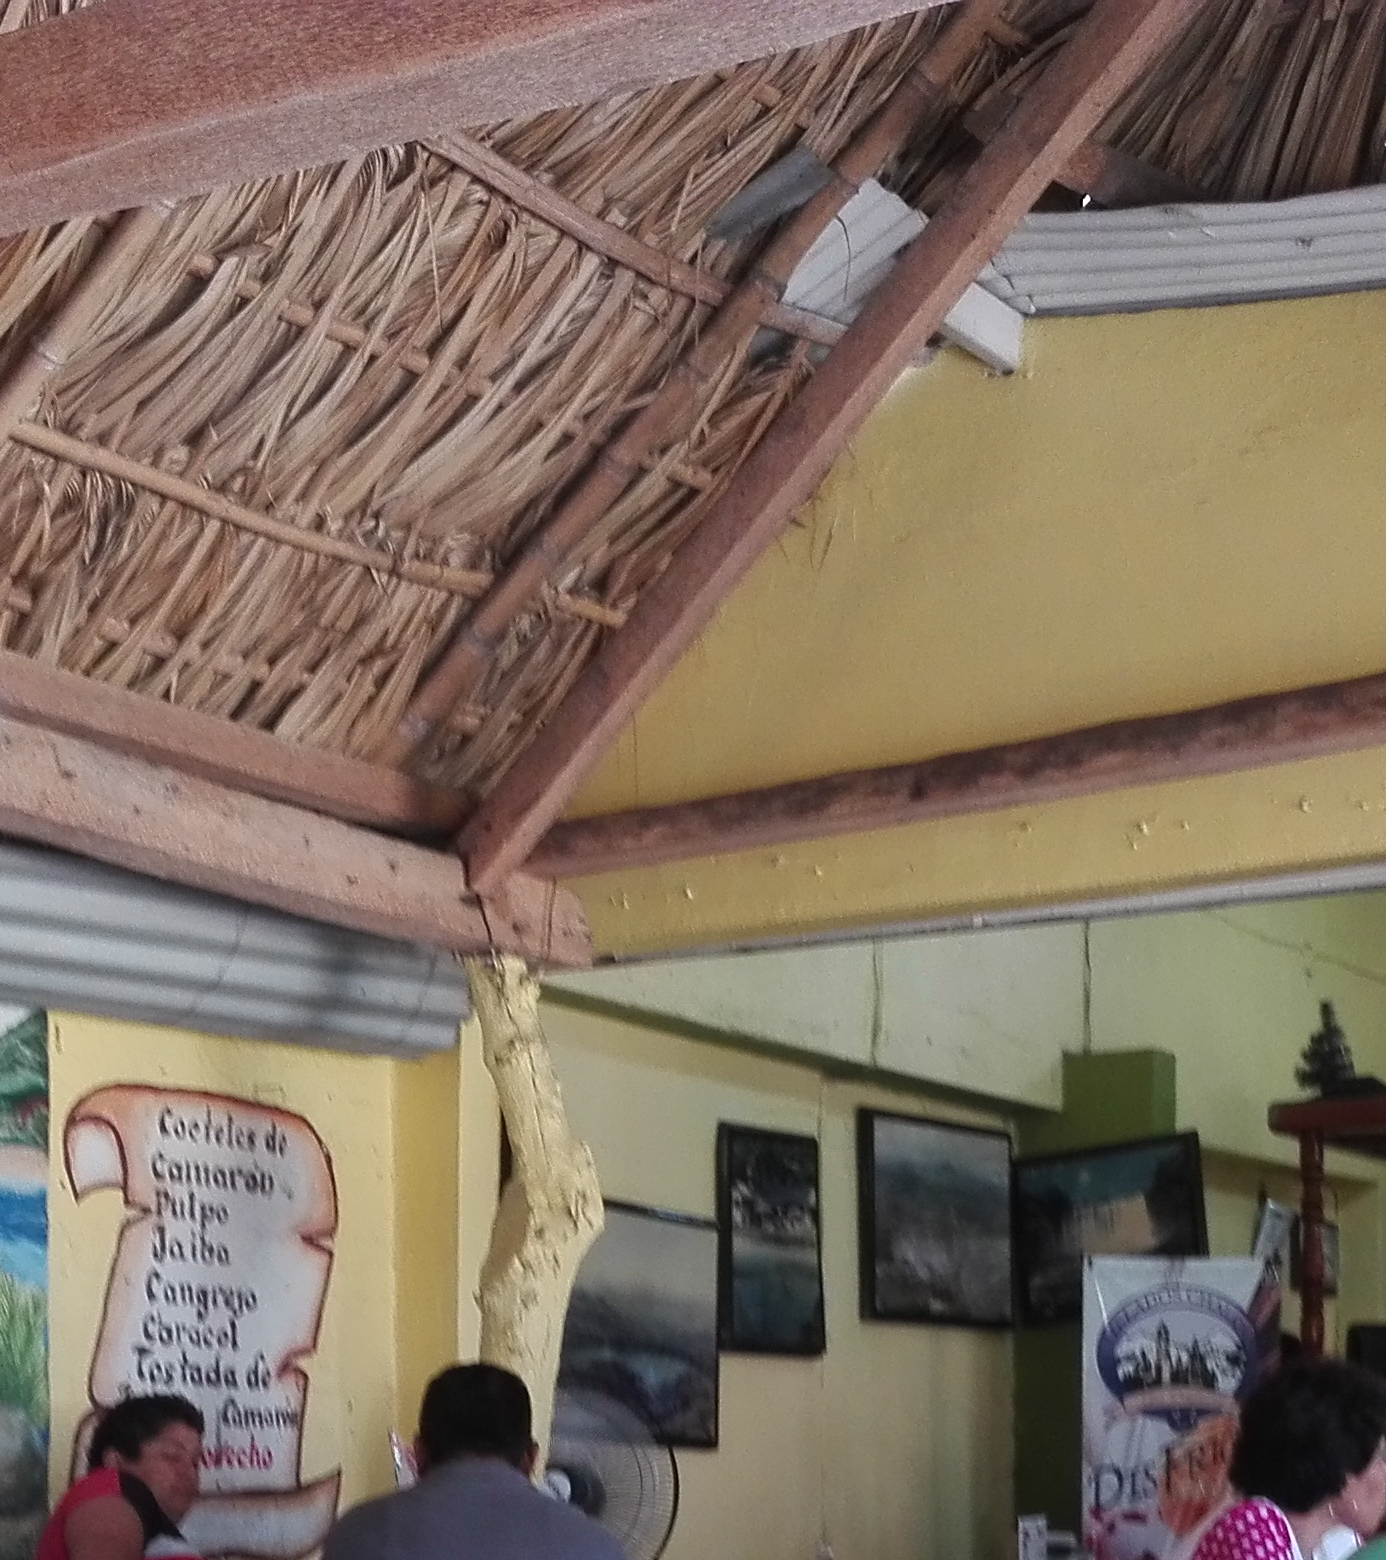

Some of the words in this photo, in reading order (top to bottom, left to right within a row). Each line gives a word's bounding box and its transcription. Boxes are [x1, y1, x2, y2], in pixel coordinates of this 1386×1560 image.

[158, 1103, 257, 1152] Cocteles
[264, 1118, 288, 1158] de
[154, 1187, 229, 1232] Pulpo
[151, 1224, 231, 1266] Jaiba
[144, 1267, 258, 1321] Cangrejo
[132, 1344, 239, 1388] Tostada
[246, 1351, 271, 1390] de
